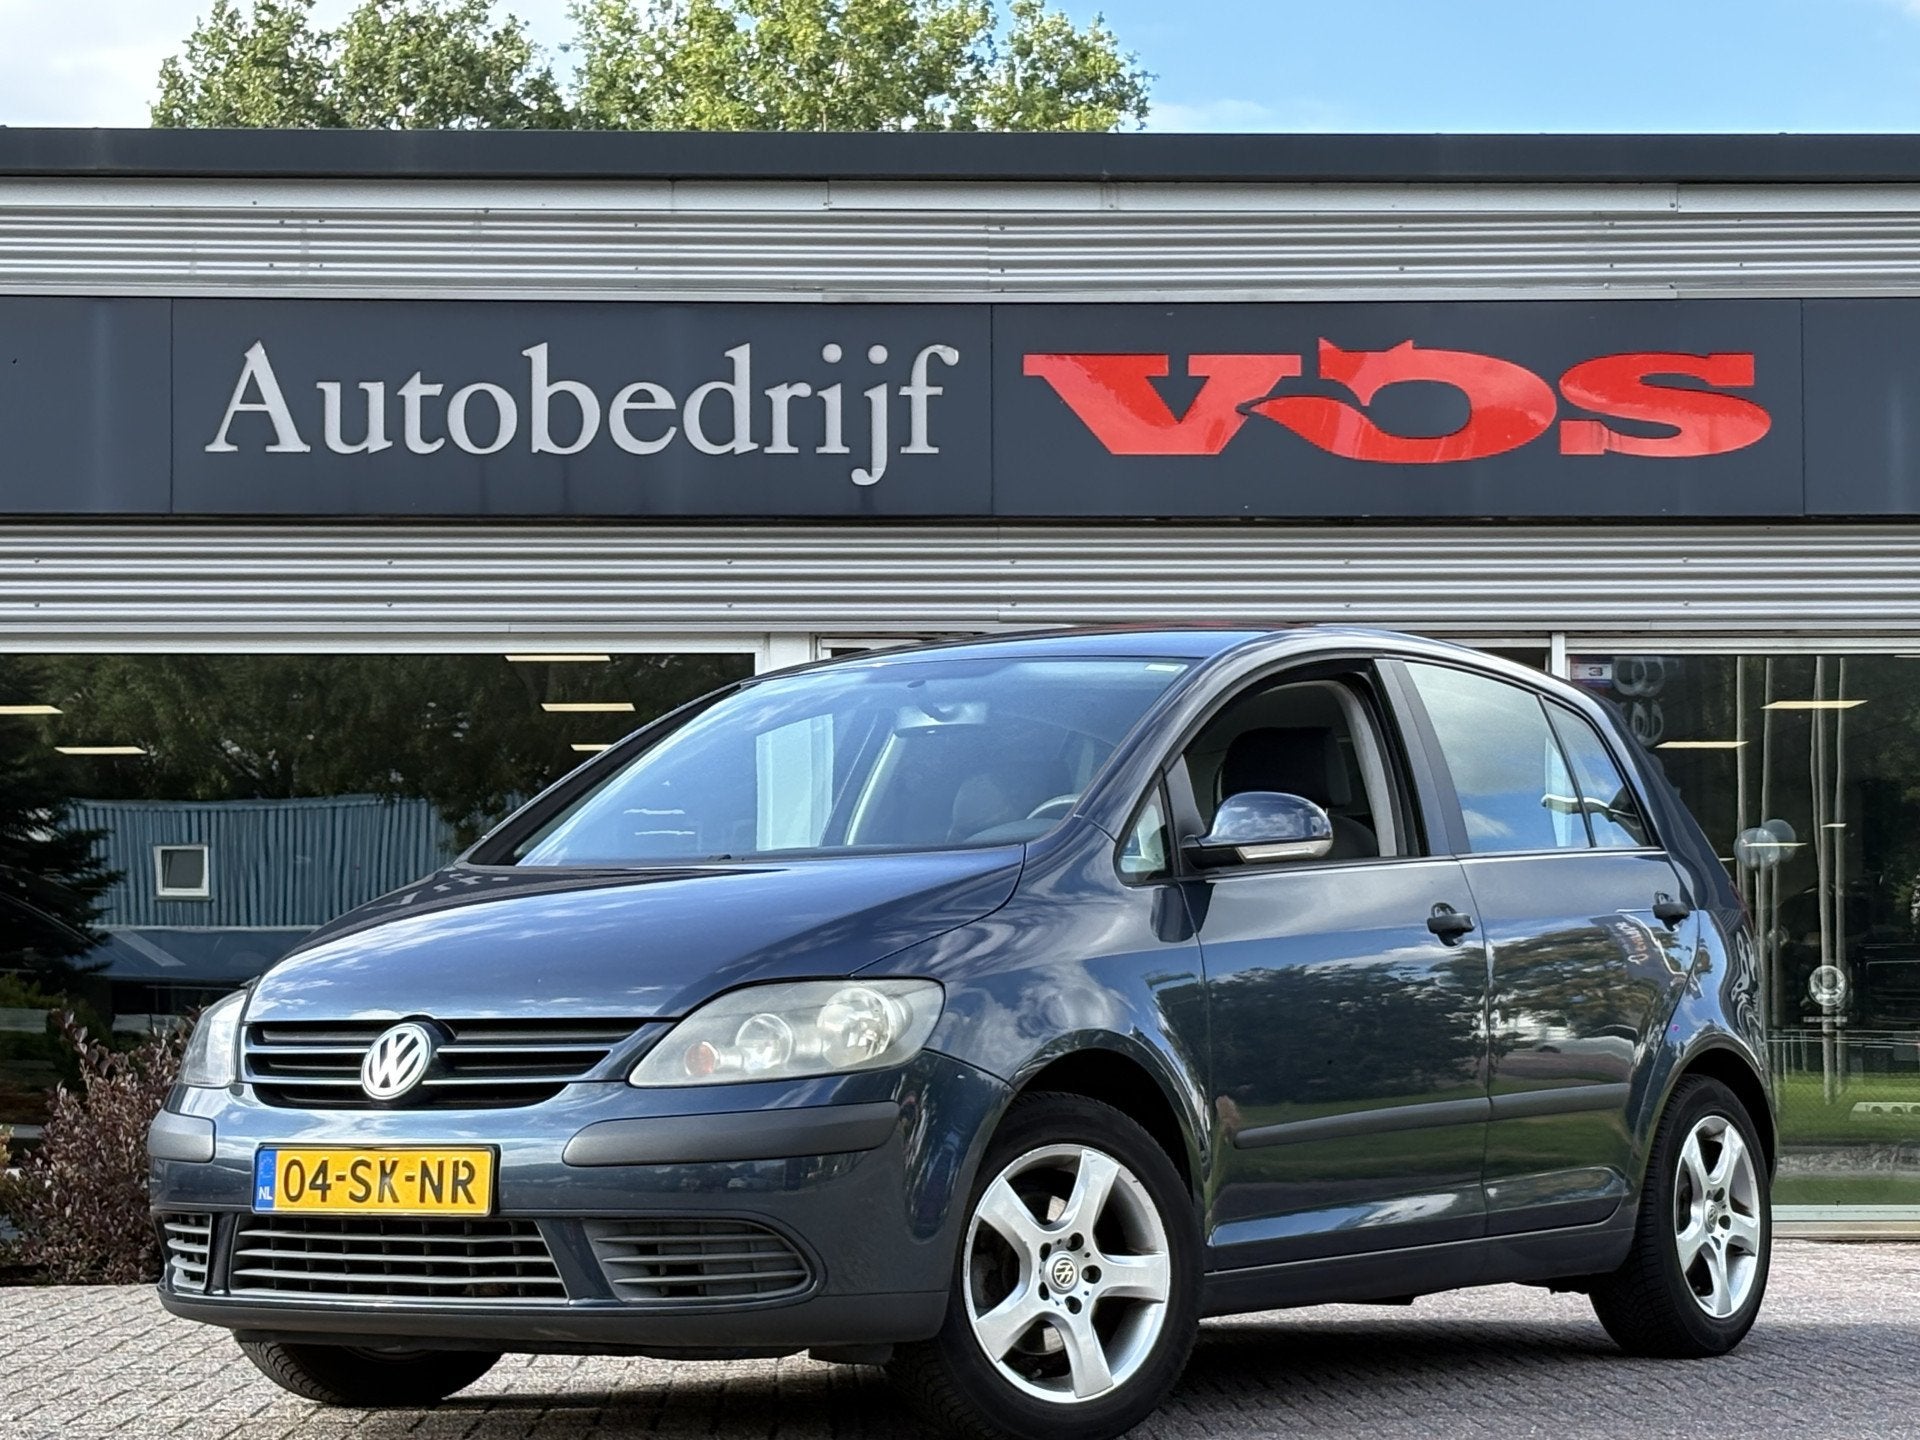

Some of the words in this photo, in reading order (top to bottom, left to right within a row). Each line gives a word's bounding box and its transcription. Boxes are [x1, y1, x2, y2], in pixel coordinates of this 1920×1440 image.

[204, 340, 960, 487] Autobedrijf
[1023, 337, 1772, 464] VOS
[259, 1186, 273, 1200] NL
[283, 1158, 477, 1204] 04-SK-NR
